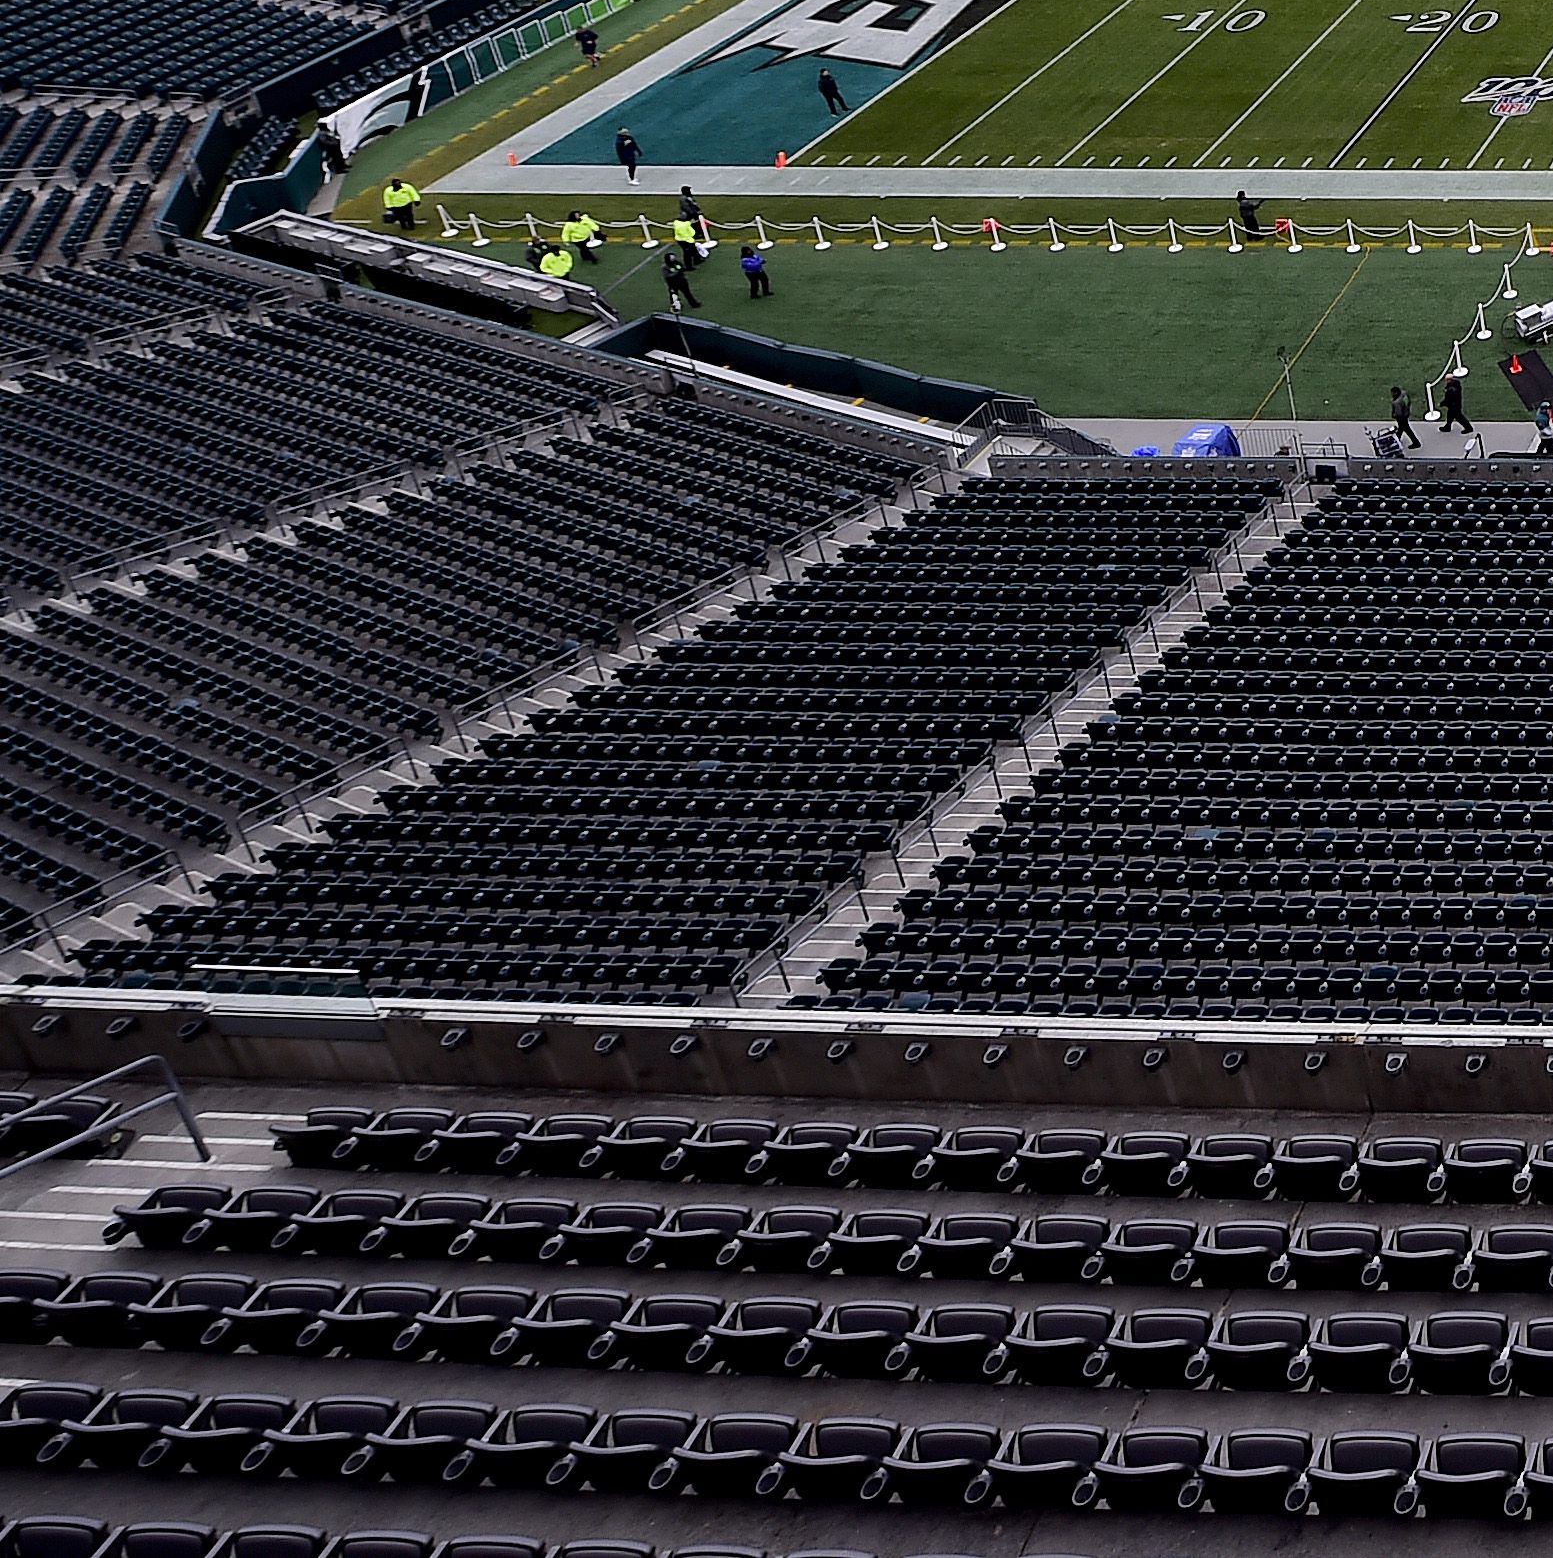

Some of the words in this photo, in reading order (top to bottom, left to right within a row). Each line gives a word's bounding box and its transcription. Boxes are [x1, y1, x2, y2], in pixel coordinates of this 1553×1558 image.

[1177, 9, 1268, 33] 10
[1404, 10, 1500, 34] 20
[1498, 103, 1527, 114] NFL
